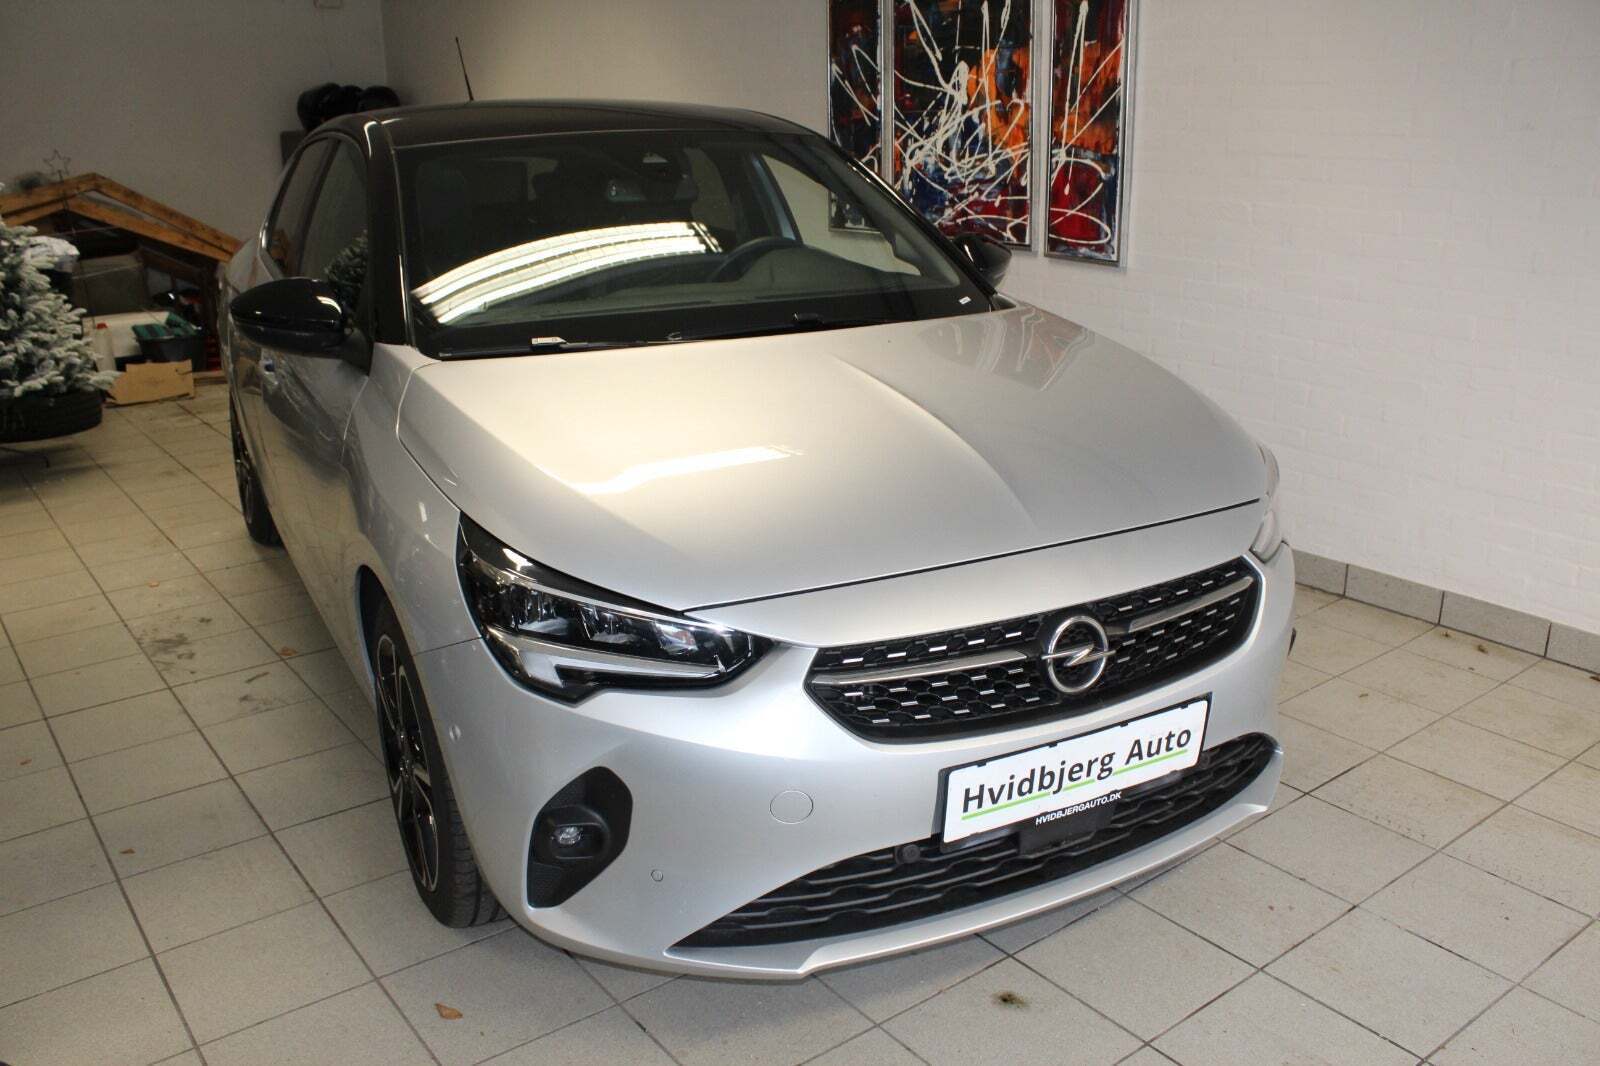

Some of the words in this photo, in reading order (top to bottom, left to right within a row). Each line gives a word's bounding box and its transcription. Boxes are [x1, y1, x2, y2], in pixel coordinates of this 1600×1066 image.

[962, 751, 1116, 813] Hvidbjerg
[1125, 728, 1192, 765] Auto
[1035, 791, 1122, 826] HVIDBJERGAUTO.DK
